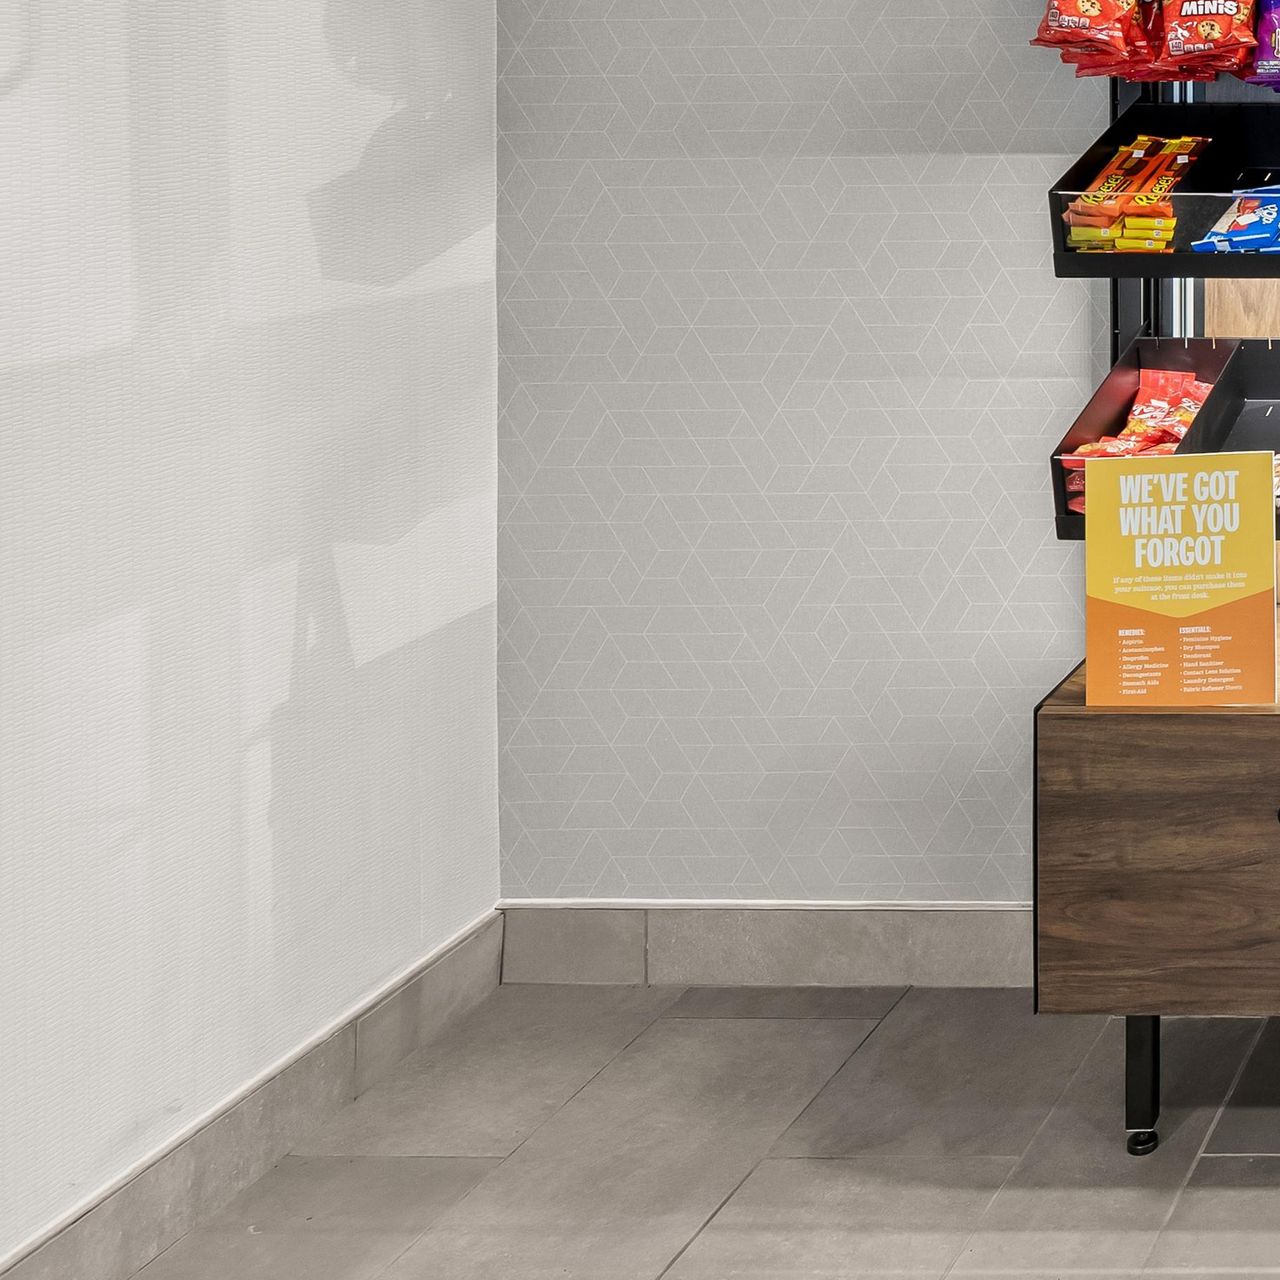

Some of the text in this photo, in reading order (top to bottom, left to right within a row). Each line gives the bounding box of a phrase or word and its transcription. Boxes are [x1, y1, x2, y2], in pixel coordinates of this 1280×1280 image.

[1119, 471, 1240, 504] WE'VE GOT
[1119, 503, 1240, 536] WHAT YOU
[1135, 536, 1225, 568] FORGOT
